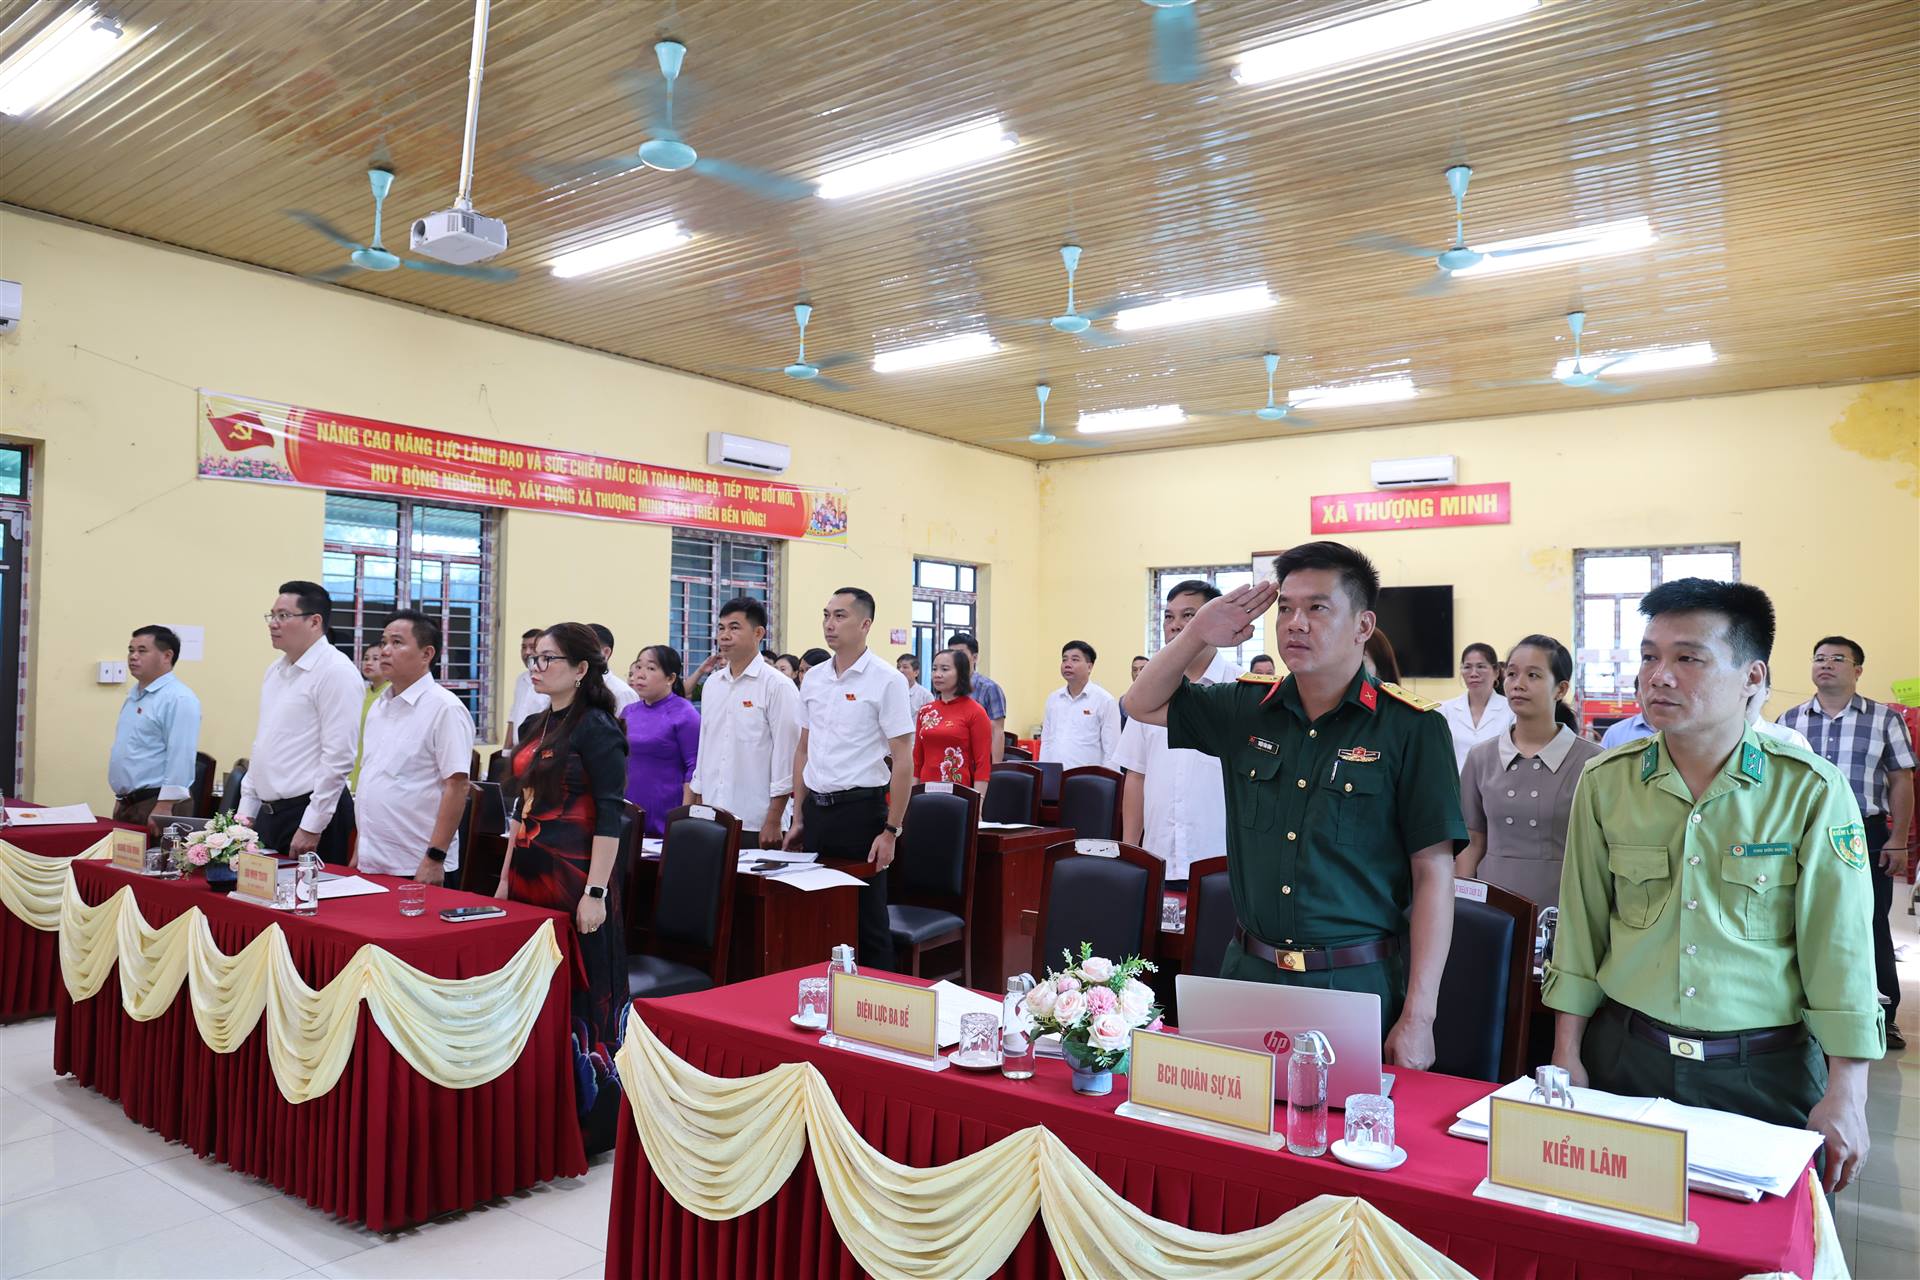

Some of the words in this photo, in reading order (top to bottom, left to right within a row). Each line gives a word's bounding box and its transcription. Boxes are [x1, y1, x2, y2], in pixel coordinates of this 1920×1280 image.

[363, 429, 391, 450] CAO
[394, 432, 433, 457] NĂNG
[436, 439, 460, 463] LỰC
[463, 441, 497, 464] LÃNH
[500, 449, 524, 471] ĐẠO
[526, 452, 542, 472] VÀ
[628, 464, 649, 486] CỦA
[651, 469, 677, 490] TOÀN
[723, 481, 742, 499] TIẾP
[743, 485, 759, 503] TỤC
[370, 463, 398, 483] HUY
[401, 464, 439, 490] ĐỘNG
[489, 479, 516, 500] LỰC,
[519, 480, 542, 502] XÂY
[578, 486, 593, 507] XÃ
[595, 491, 636, 513] THƯỢNG
[638, 498, 664, 515] MINH
[1322, 501, 1348, 524] XÃ
[1353, 497, 1434, 524] THƯỢNG
[1440, 494, 1498, 517] MINH
[857, 998, 873, 1022] ĐIỆN
[874, 1003, 887, 1026] LỰC
[888, 1007, 898, 1025] BA
[1267, 1031, 1289, 1053] hp
[1157, 1063, 1177, 1085] BCH
[1180, 1067, 1208, 1093] QUÂN
[1211, 1074, 1226, 1100] SỰ
[1227, 1076, 1242, 1100] XÃ
[1542, 1135, 1585, 1171] KIỂM
[1590, 1146, 1627, 1179] LÂM
